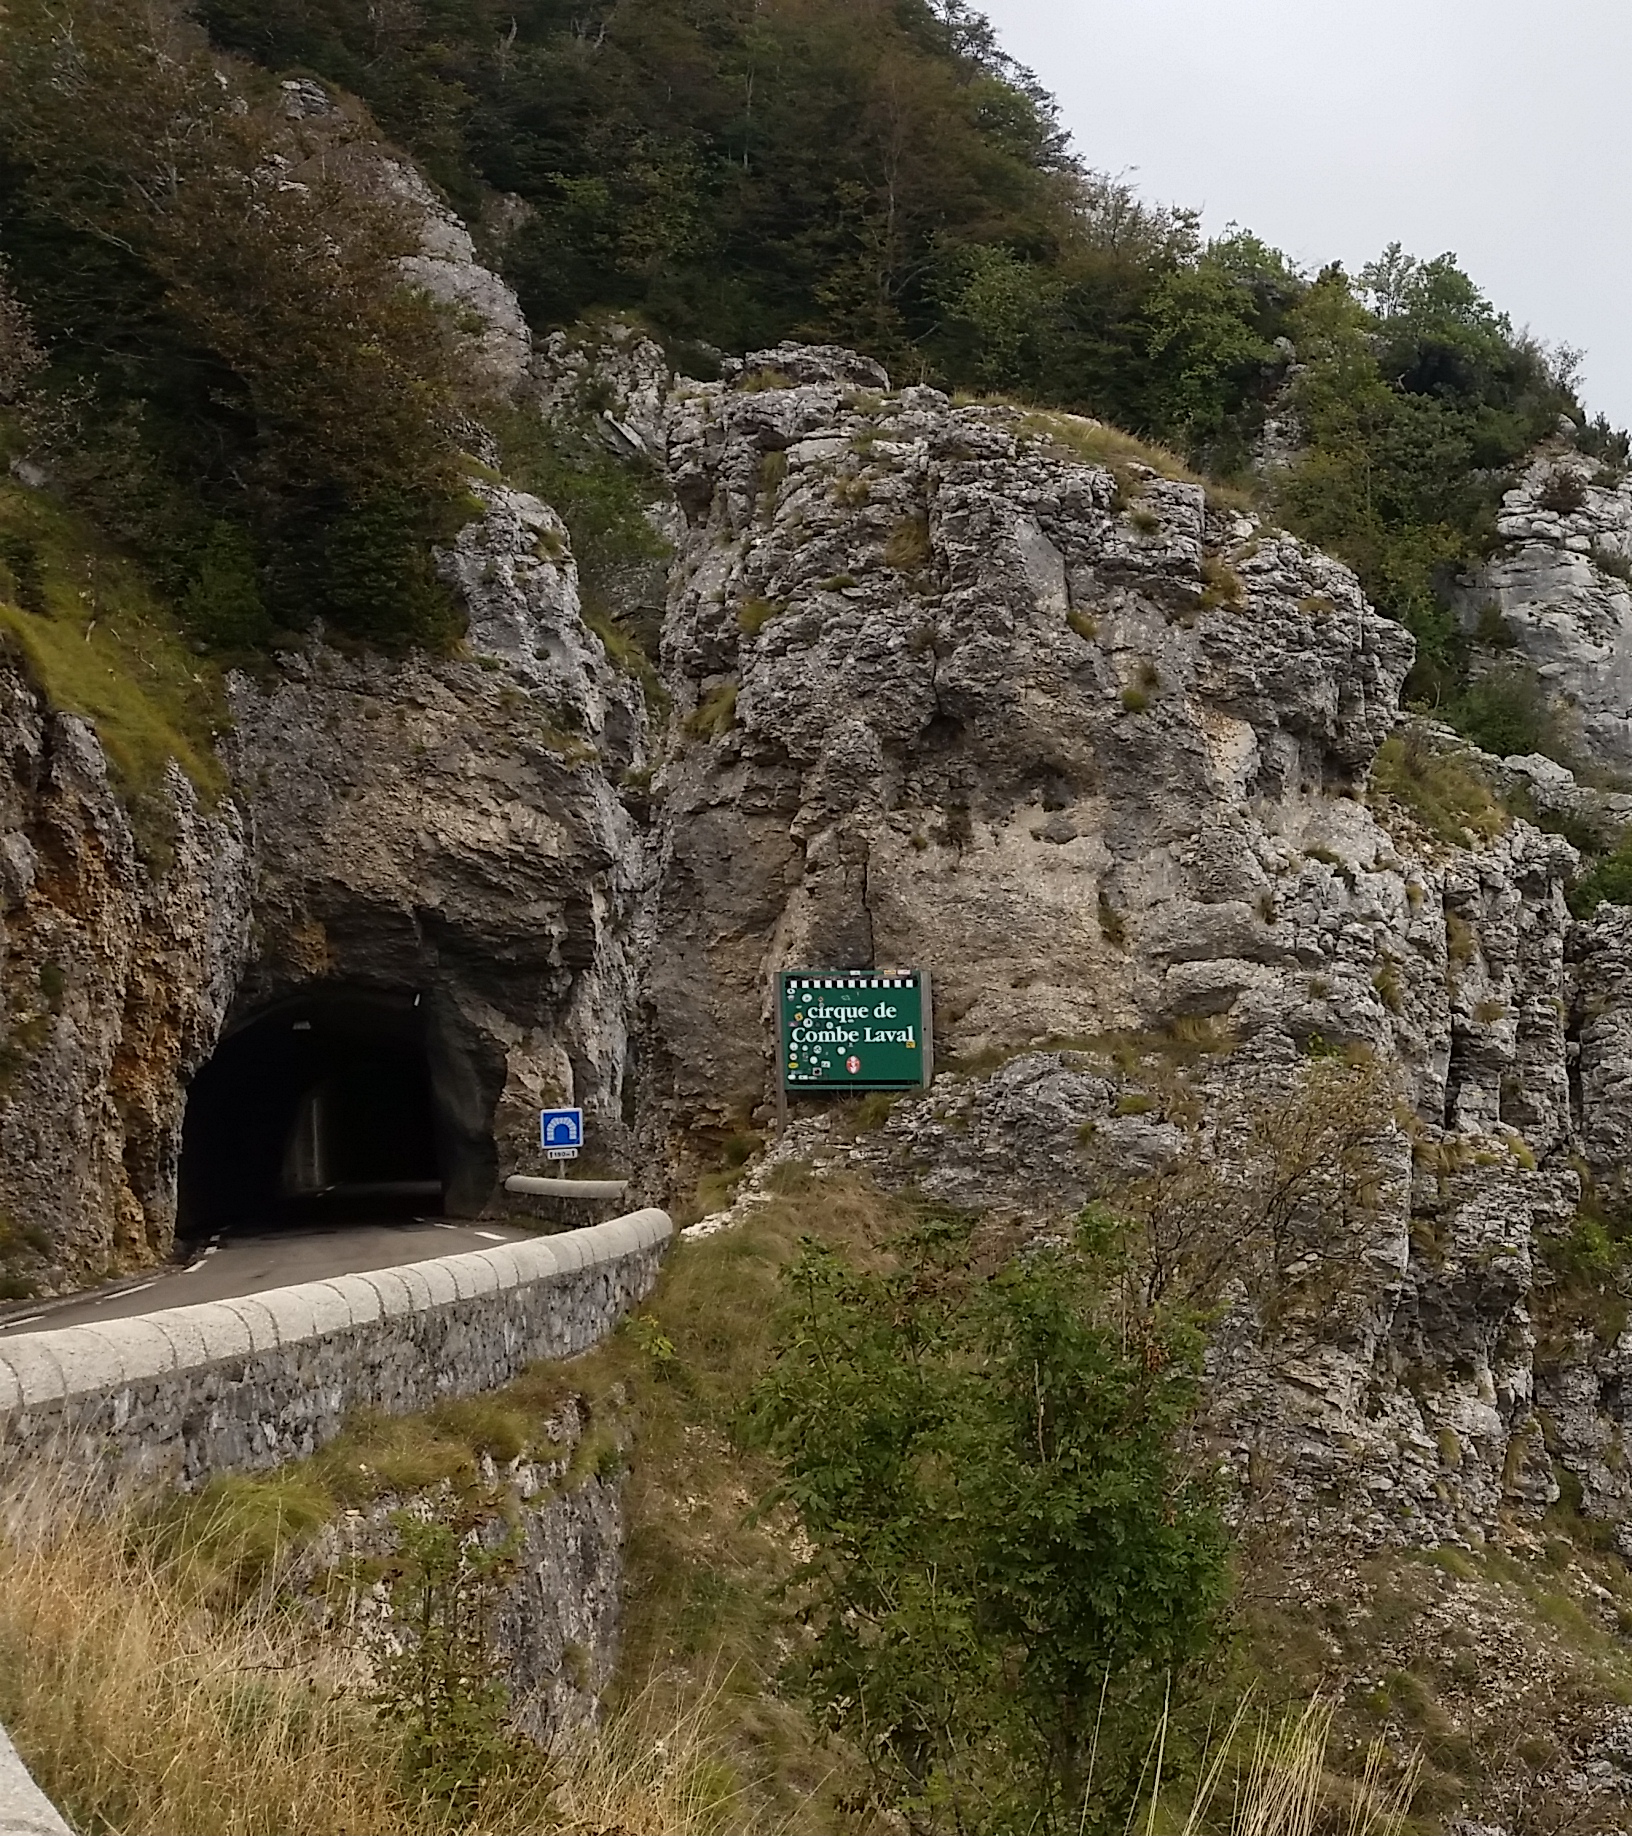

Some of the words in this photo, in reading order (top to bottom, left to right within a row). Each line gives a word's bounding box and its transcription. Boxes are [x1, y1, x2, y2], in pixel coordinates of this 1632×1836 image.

[807, 1004, 869, 1023] cirque
[873, 1001, 897, 1019] de
[791, 1026, 860, 1043] Combe
[863, 1025, 915, 1043] Laval
